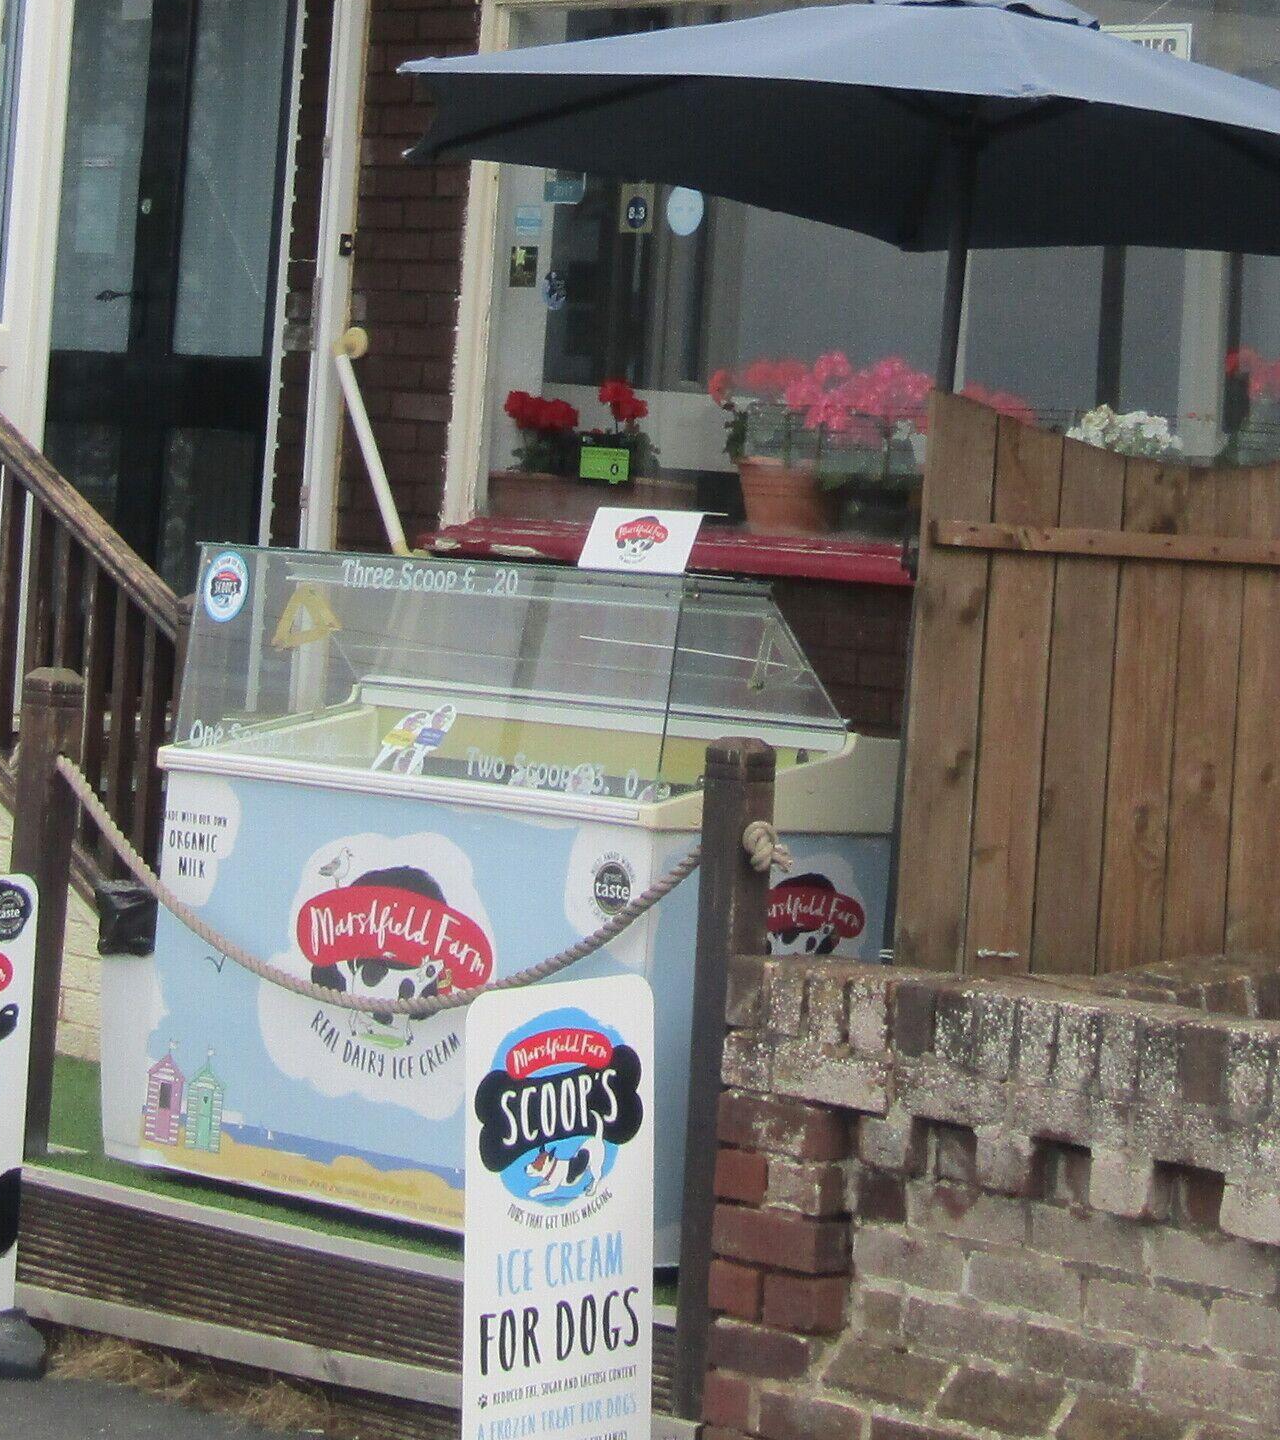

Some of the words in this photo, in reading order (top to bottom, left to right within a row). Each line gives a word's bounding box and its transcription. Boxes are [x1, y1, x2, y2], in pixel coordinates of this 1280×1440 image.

[341, 559, 395, 589] Three
[399, 562, 458, 593] Scoop
[467, 746, 506, 780] Two
[169, 829, 218, 854] ORGANIC
[178, 856, 206, 879] MILK
[595, 881, 630, 900] taste
[310, 899, 432, 957] Marshfield
[433, 913, 486, 977] Farm
[310, 1009, 341, 1053] REAL
[342, 1038, 385, 1078] DAIRY
[392, 1056, 414, 1080] ICE
[420, 1031, 461, 1077] CREAM
[512, 1033, 579, 1076] Marshfield
[580, 1033, 608, 1058] Farm
[500, 1068, 618, 1146] SCOOP'S
[496, 1248, 534, 1297] ICE
[544, 1229, 624, 1288] CREAM
[479, 1306, 541, 1377] FOR
[555, 1285, 640, 1362] DOGS
[492, 1388, 524, 1406] REDUCED
[540, 1378, 563, 1397] SUGAR
[563, 1376, 579, 1391] AND
[579, 1370, 608, 1389] LACTOSE
[608, 1364, 638, 1383] CONTENT
[490, 1412, 537, 1440] FROZEN
[541, 1404, 576, 1432] TREAT
[580, 1398, 603, 1424] FOR
[606, 1391, 638, 1417] DOGS
